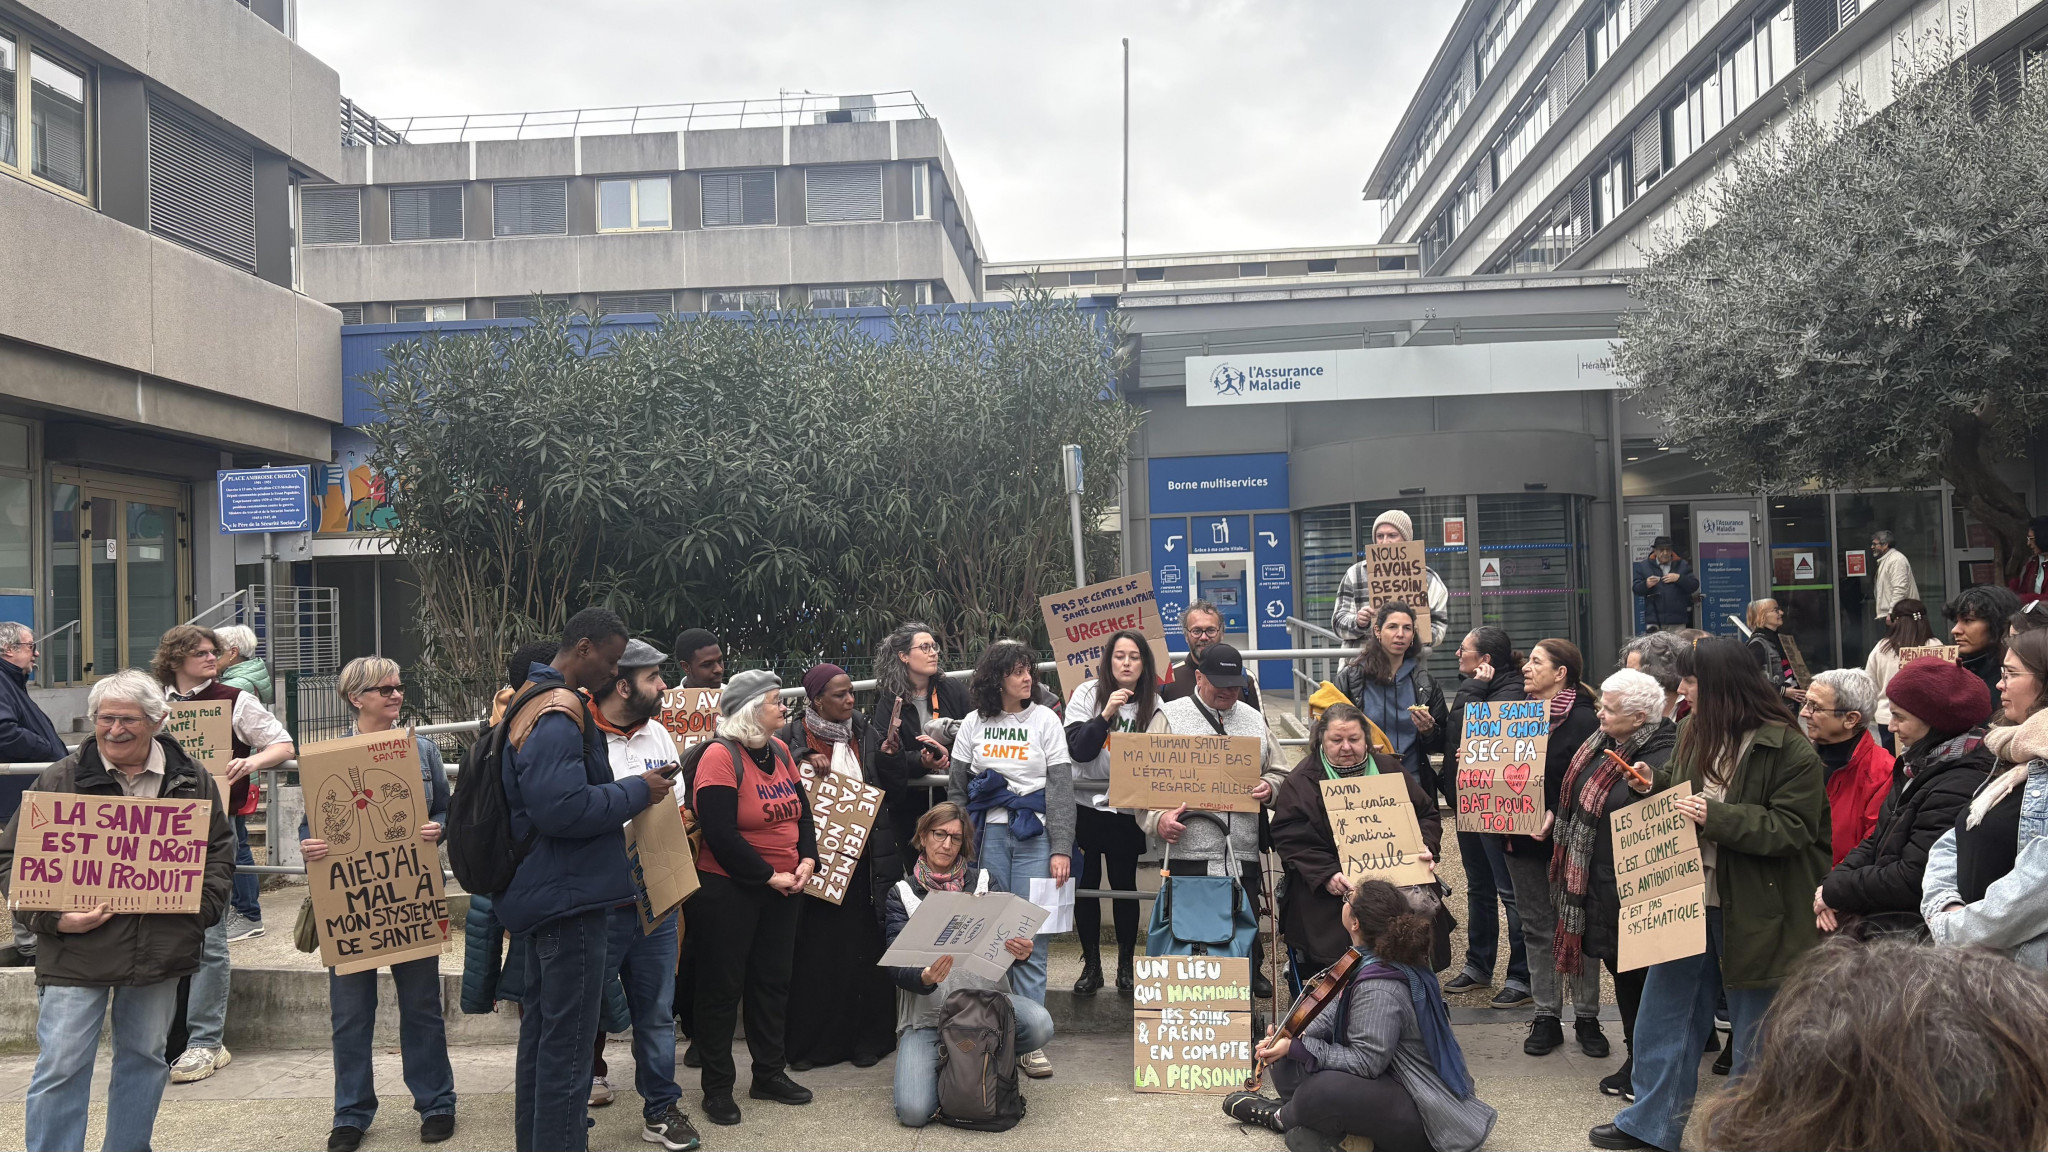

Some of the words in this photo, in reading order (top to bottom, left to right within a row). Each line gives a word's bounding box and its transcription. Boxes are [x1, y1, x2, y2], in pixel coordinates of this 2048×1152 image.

[1248, 366, 1324, 378] l'Assurance
[1249, 378, 1301, 391] Maladie
[1168, 480, 1198, 491] Borne
[1200, 477, 1268, 489] multiservices
[1371, 546, 1407, 562] NOUS
[1373, 559, 1422, 578] AVONS
[1051, 599, 1076, 616] PAS
[1078, 595, 1090, 607] DE
[1090, 585, 1124, 602] CENTRE
[1125, 580, 1138, 592] DE
[1062, 604, 1090, 623] SANTÉ
[1947, 647, 1956, 661] DE
[177, 710, 197, 719] BON
[199, 706, 222, 718] POUR
[1465, 702, 1491, 720] MA
[1499, 699, 1545, 720] SANTÉ
[162, 718, 190, 732] ANTÉ
[984, 727, 1029, 742] HUMAN
[1466, 720, 1502, 739] MON
[367, 739, 411, 753] HUMAN
[982, 742, 1031, 761] SANTÉ
[1194, 736, 1232, 751] SANTÉ
[1149, 751, 1165, 764] VU
[1168, 752, 1186, 765] AU
[1225, 753, 1252, 767] BAS
[1132, 765, 1176, 780] L'ÉTAT,
[1458, 769, 1495, 790] MON
[1533, 774, 1545, 788] SE
[835, 778, 862, 814] PAS
[1151, 781, 1206, 794] REGARDE
[1325, 783, 1361, 798] sans
[857, 783, 881, 817] NE
[1344, 796, 1355, 812] le
[1459, 792, 1491, 815] BAT
[1495, 795, 1535, 815] POUR
[54, 801, 87, 826] LA
[96, 802, 197, 836] SANTÉ
[1614, 812, 1633, 833] LES
[1641, 792, 1680, 822] COUPES
[1336, 813, 1349, 836] je
[1355, 814, 1382, 825] me
[1345, 827, 1396, 845] sentirai
[41, 832, 98, 855] EST
[106, 836, 140, 862] UN
[811, 821, 846, 891] NOTRE
[1617, 854, 1639, 875] C'EST
[1644, 836, 1680, 865] COMME
[824, 823, 868, 901] FERMEZ
[1347, 841, 1415, 877] seule
[19, 857, 63, 883] PAS
[72, 859, 103, 886] UN
[346, 882, 407, 914] MAL
[414, 864, 435, 900] À
[1618, 881, 1634, 901] LES
[1621, 906, 1643, 920] C'EST
[1648, 898, 1663, 913] PAS
[326, 914, 371, 938] MON
[336, 937, 364, 956] DE
[370, 919, 436, 951] SANTÉ
[1135, 959, 1169, 980] UN
[1161, 1007, 1184, 1025] LES
[1138, 1020, 1149, 1045] &
[1157, 1024, 1216, 1042] PREND
[1150, 1045, 1174, 1061] EN
[1181, 1041, 1249, 1061] COMPTE
[1135, 1064, 1161, 1088] LA
